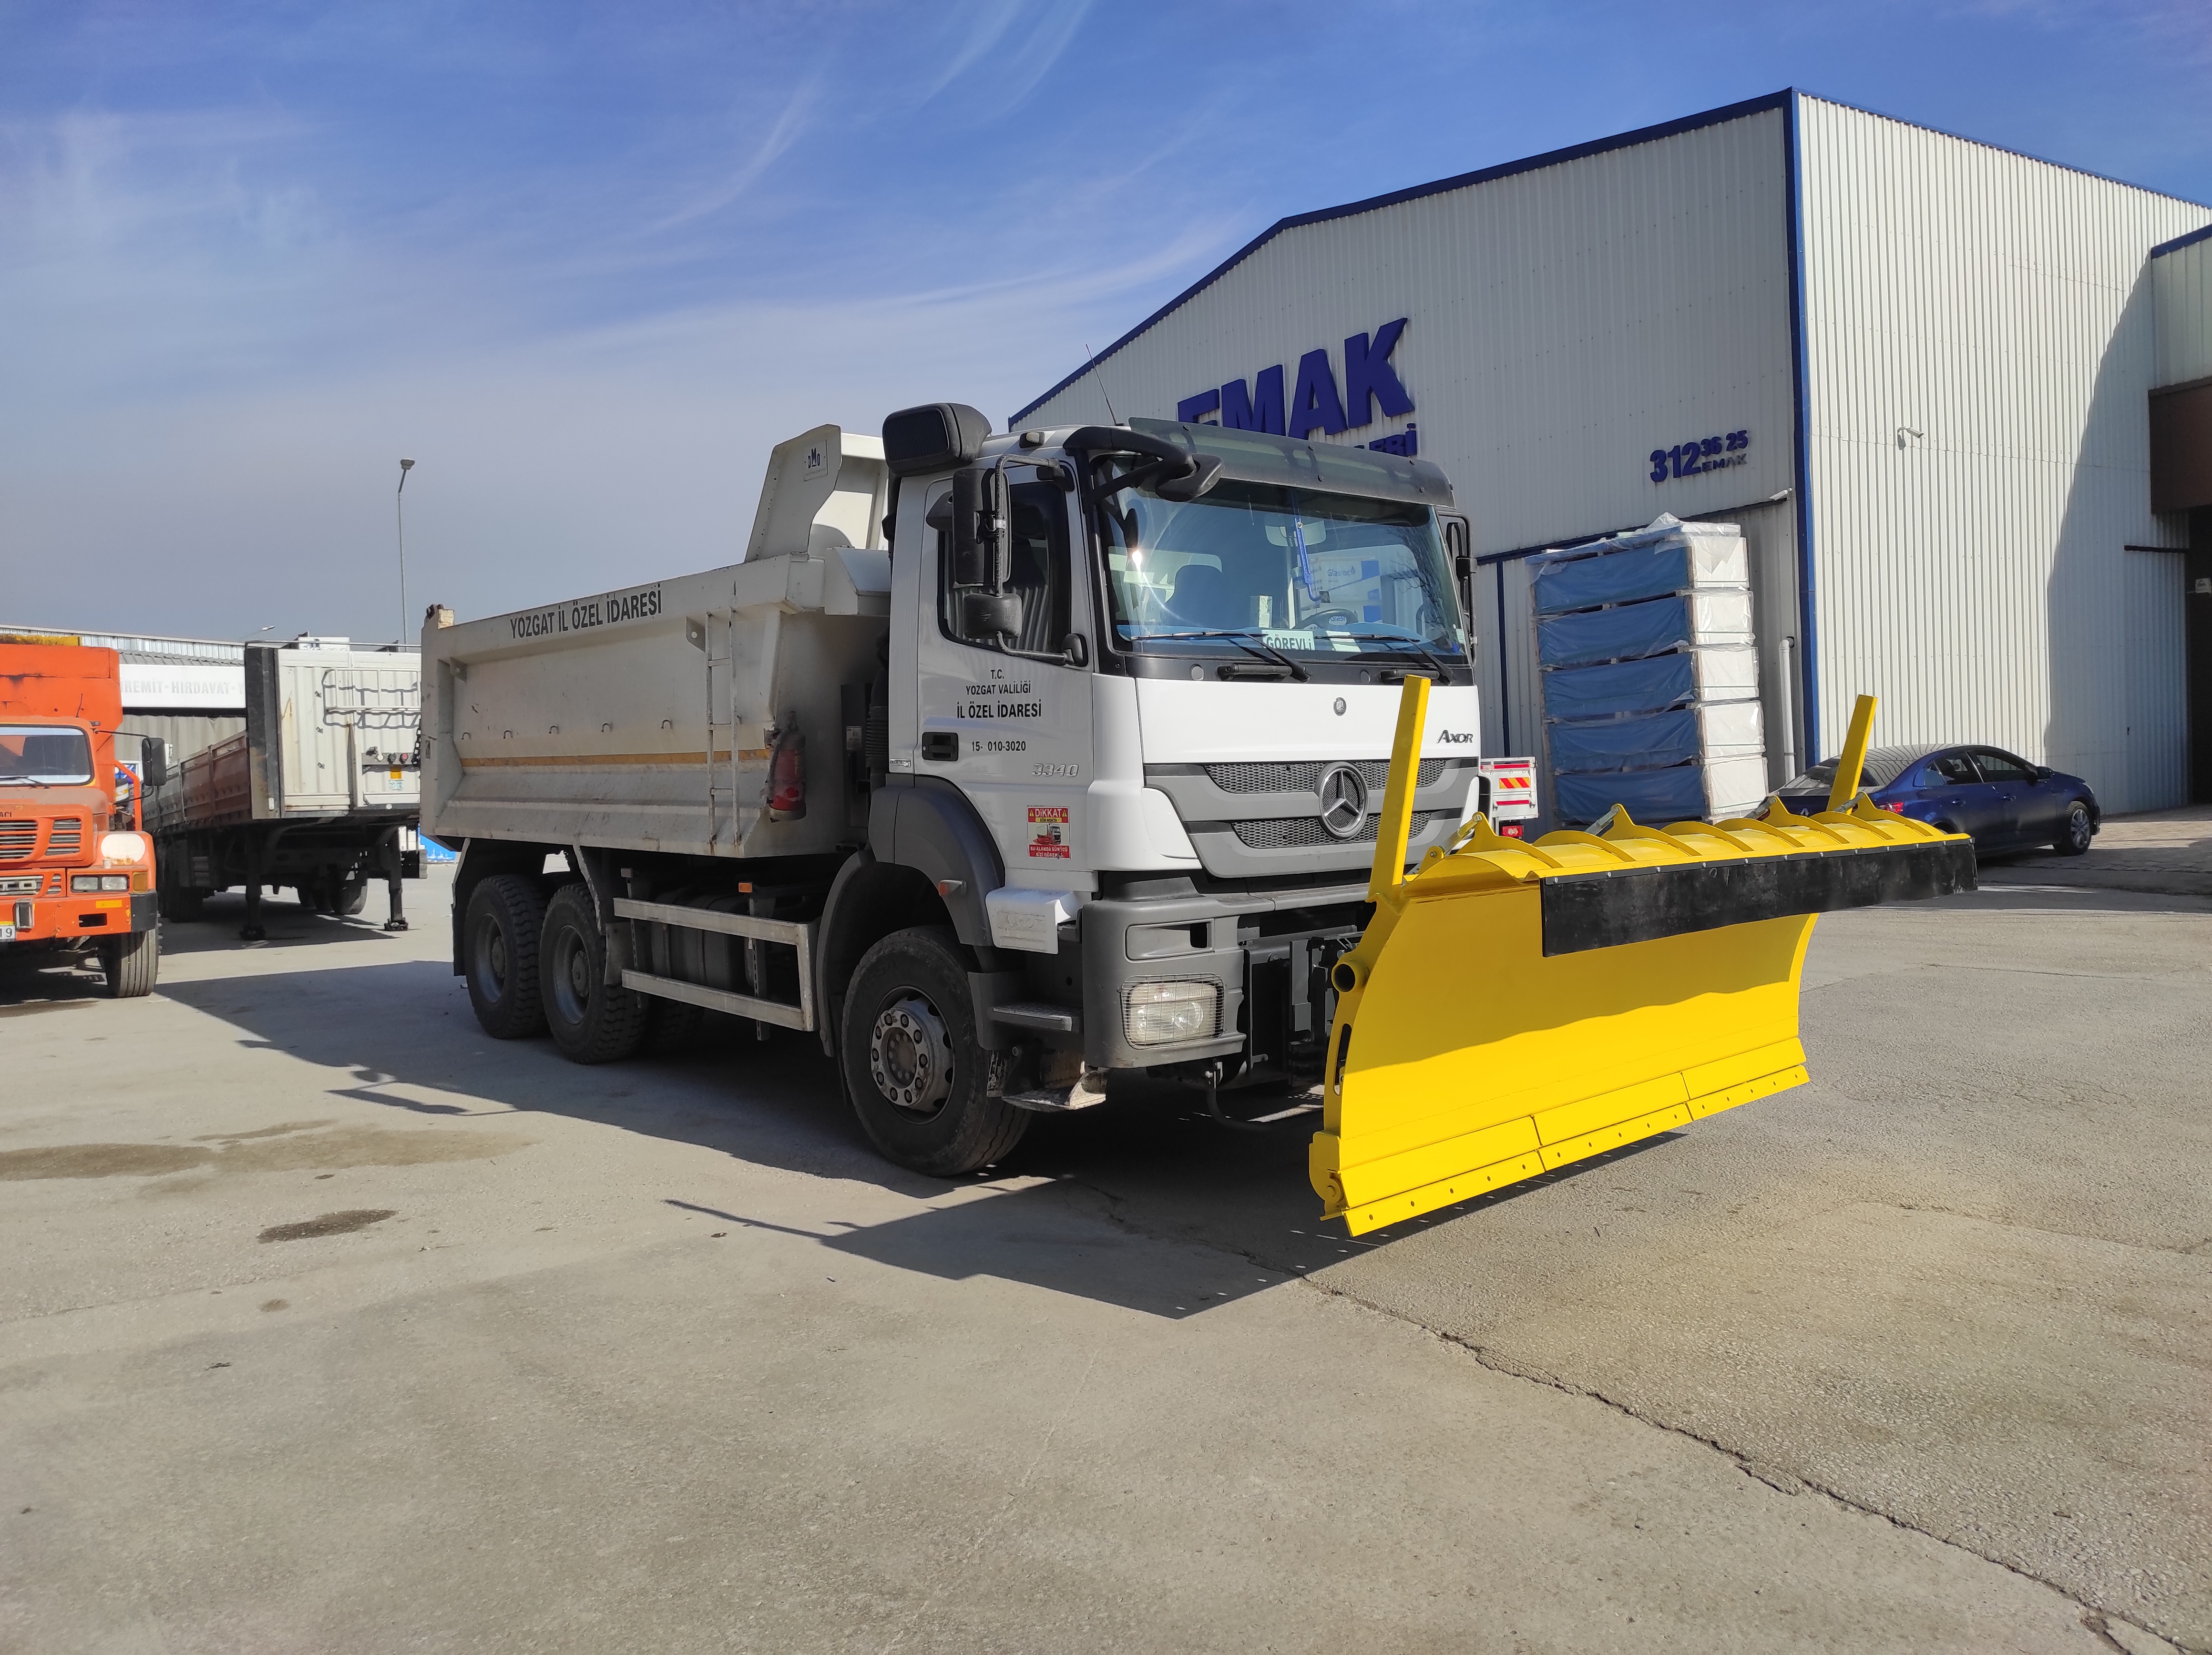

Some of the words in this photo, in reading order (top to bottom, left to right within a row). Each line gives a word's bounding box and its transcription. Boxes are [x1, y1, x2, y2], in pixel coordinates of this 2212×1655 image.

[1649, 441, 1701, 482] 312
[1700, 436, 1722, 457] 36
[1726, 429, 1748, 451] 25
[1702, 453, 1747, 472] EMAK
[510, 612, 555, 639] YOZGAT
[558, 605, 569, 633] İL
[572, 601, 603, 630] ÖZEL
[607, 582, 662, 623] İDARESİ
[990, 669, 1004, 679] T.C.
[172, 681, 230, 694] HIRDAVAT
[965, 684, 996, 695] YOZGAT
[998, 680, 1031, 695] VALİLİĞİ
[957, 701, 965, 718] İL
[968, 701, 994, 718] ÖZEL
[997, 698, 1042, 718] İDARESİ
[972, 741, 983, 752] 15-
[987, 740, 1026, 752] 010-3020
[1032, 763, 1079, 777] 3340
